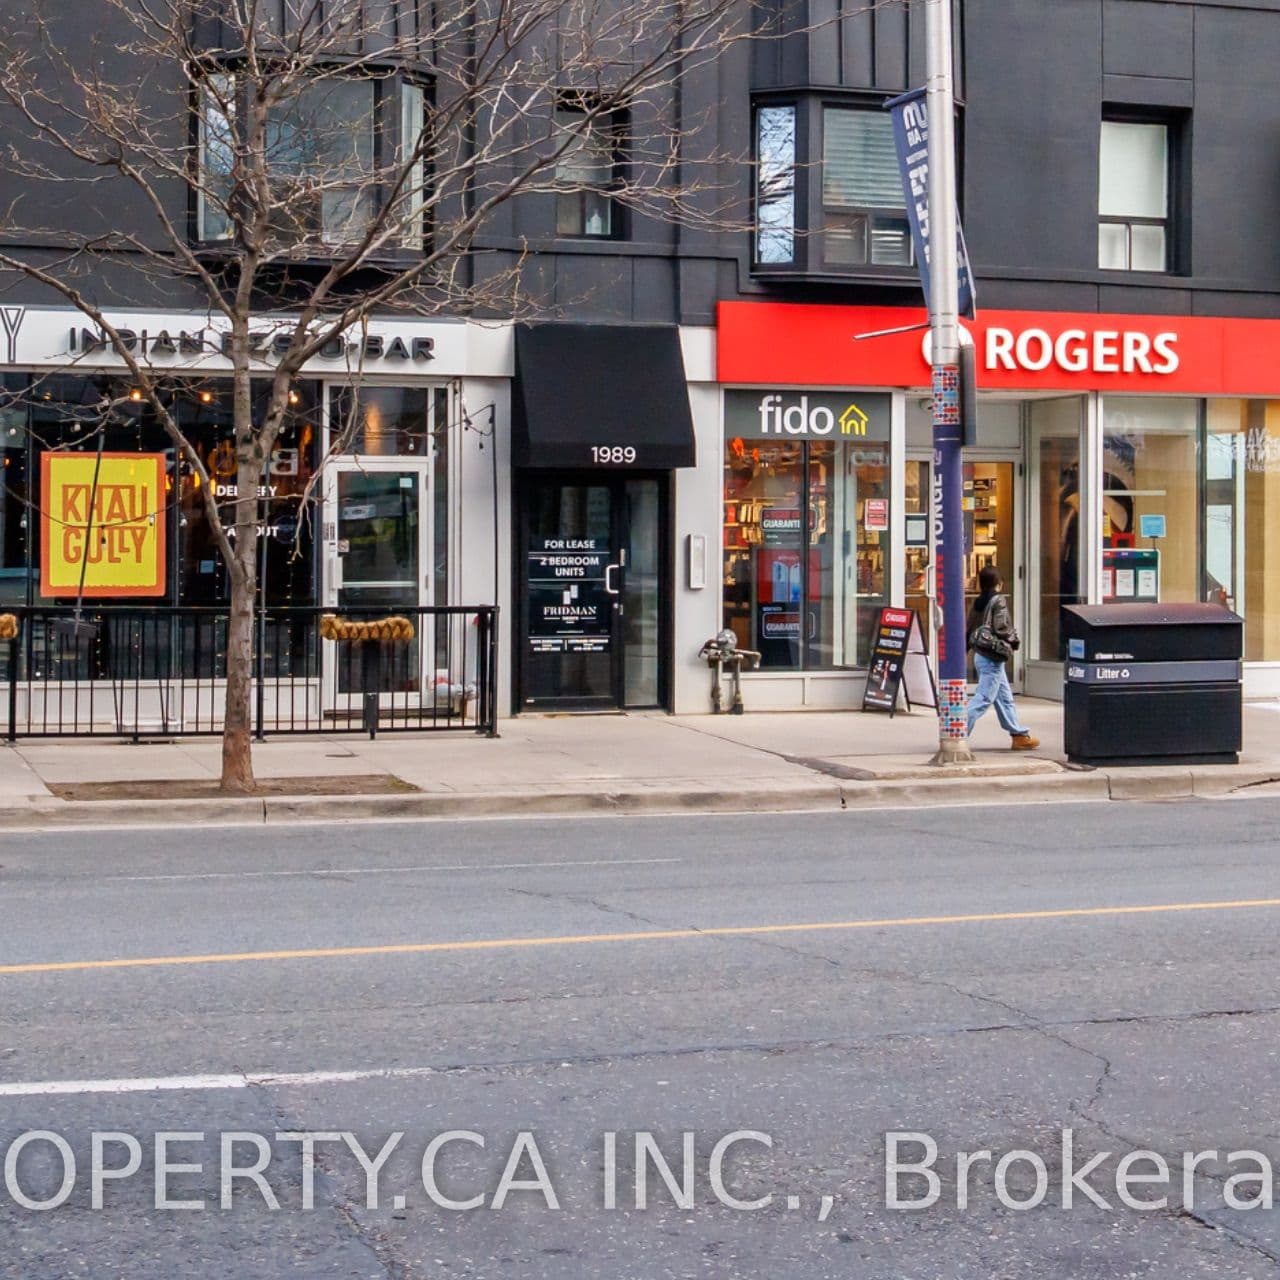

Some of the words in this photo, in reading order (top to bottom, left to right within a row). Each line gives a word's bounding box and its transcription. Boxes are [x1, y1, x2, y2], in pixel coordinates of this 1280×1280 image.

[69, 327, 205, 353] INDIAN
[221, 332, 435, 360] ESO-BAR
[985, 327, 1180, 374] ROGERS
[758, 395, 835, 435] fido
[591, 446, 636, 464] 1989
[216, 485, 277, 497] DELERY
[62, 485, 148, 523] KHAU
[62, 526, 148, 564] GULLY
[544, 540, 564, 549] FOR
[566, 540, 596, 549] LEASE
[548, 556, 600, 566] BEDROOM
[555, 567, 585, 577] UNITS
[543, 606, 597, 615] FRIDMAN
[1096, 667, 1120, 679] Litter
